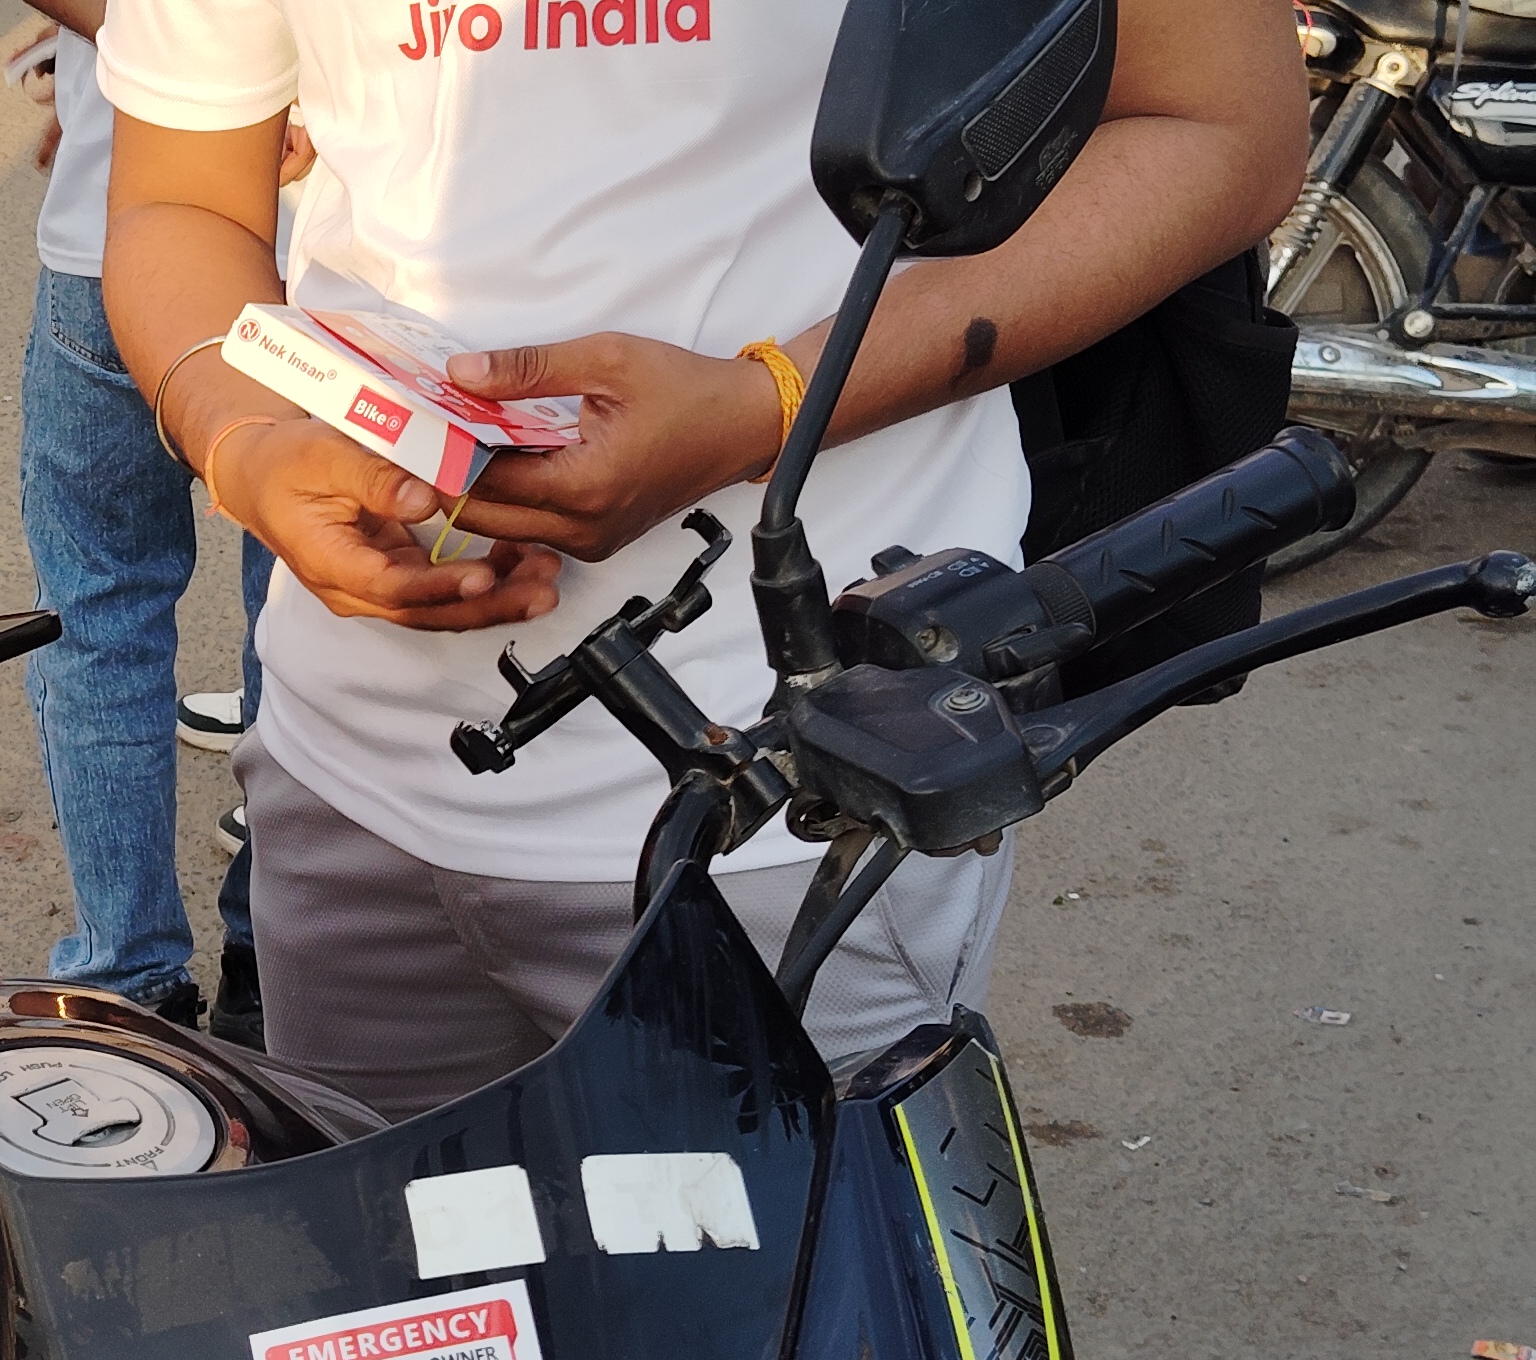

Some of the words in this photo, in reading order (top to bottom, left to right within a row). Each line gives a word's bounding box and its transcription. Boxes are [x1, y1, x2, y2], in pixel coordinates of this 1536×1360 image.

[258, 334, 287, 360] Nek
[353, 399, 387, 426] Bike
[115, 1145, 165, 1168] FRONT
